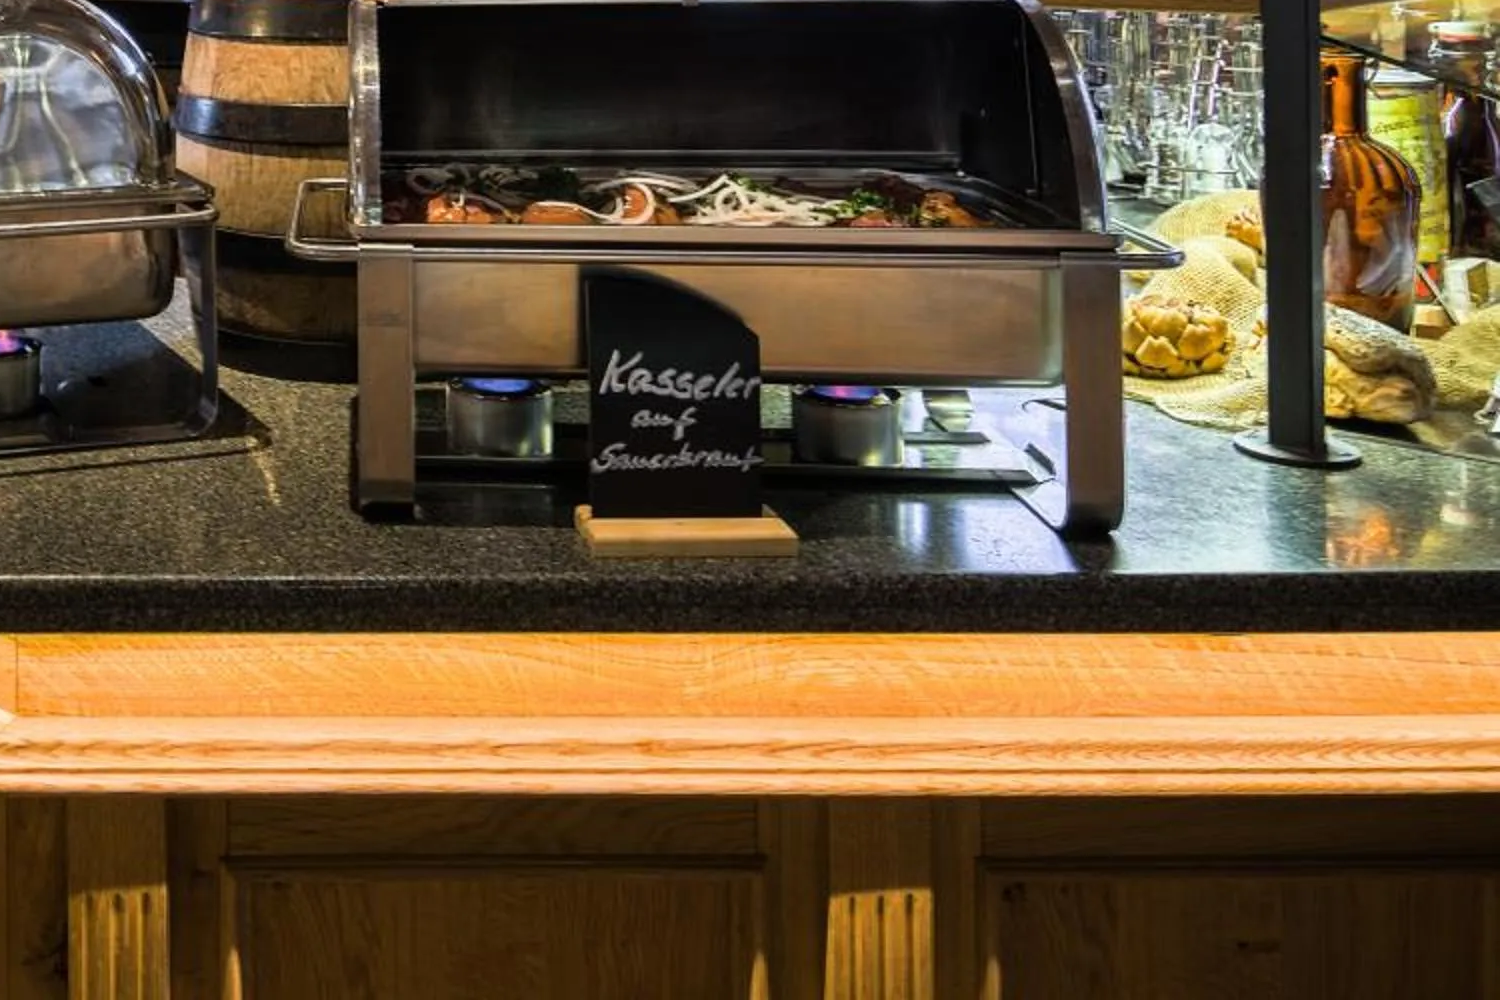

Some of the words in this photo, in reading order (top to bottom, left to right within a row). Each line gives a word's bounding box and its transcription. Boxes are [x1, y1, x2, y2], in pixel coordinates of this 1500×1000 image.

[600, 349, 762, 400] Kasseler
[631, 407, 697, 440] auf
[590, 442, 764, 473] Sauerkraut
